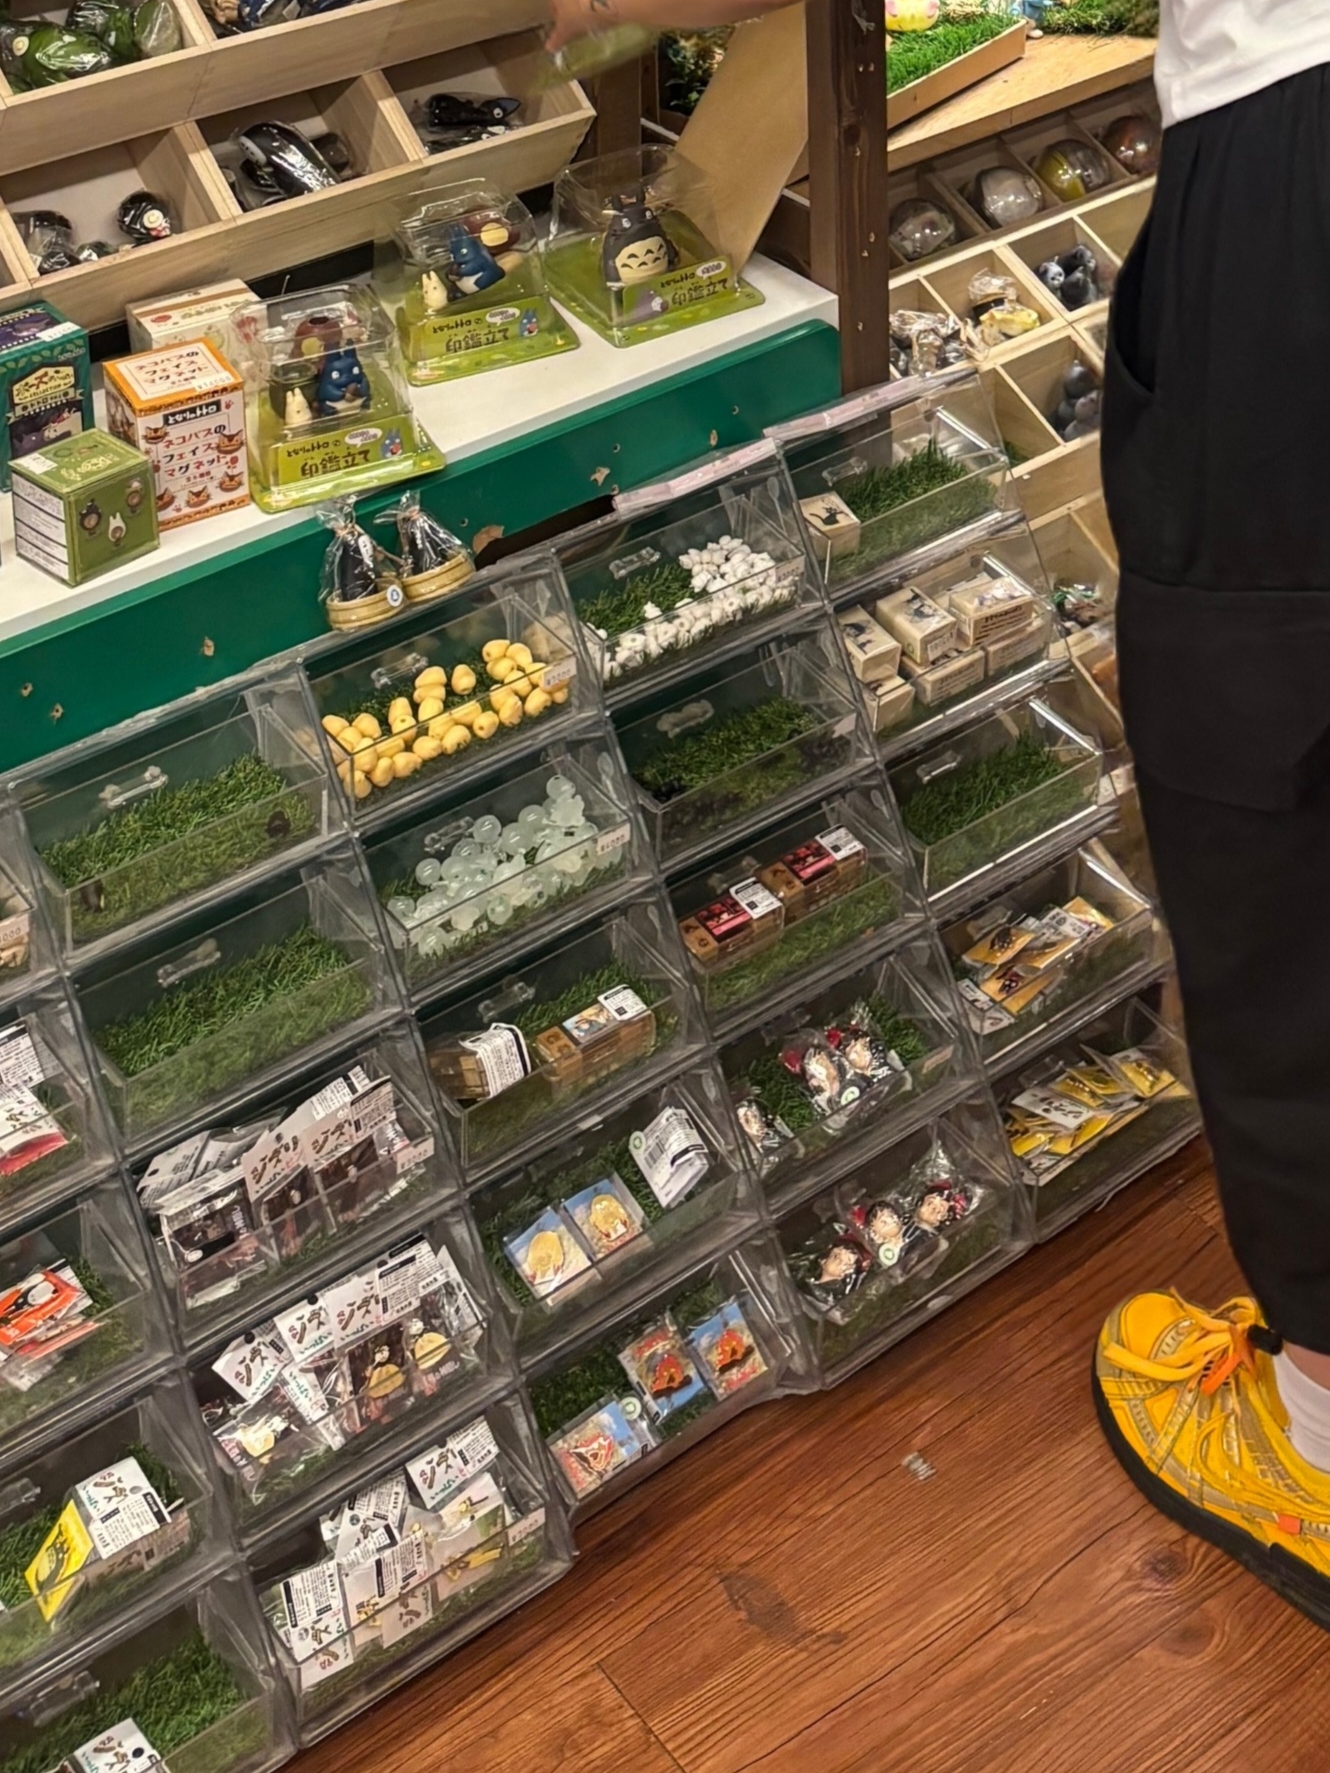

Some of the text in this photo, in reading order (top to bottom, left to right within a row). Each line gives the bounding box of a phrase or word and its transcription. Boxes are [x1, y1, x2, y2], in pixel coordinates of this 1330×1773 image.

[445, 328, 510, 353] 印鑑立て
[163, 424, 226, 449] ネコバスの
[163, 443, 217, 465] フェイス
[164, 455, 227, 477] マグネット
[300, 449, 371, 478] 印鑑立て
